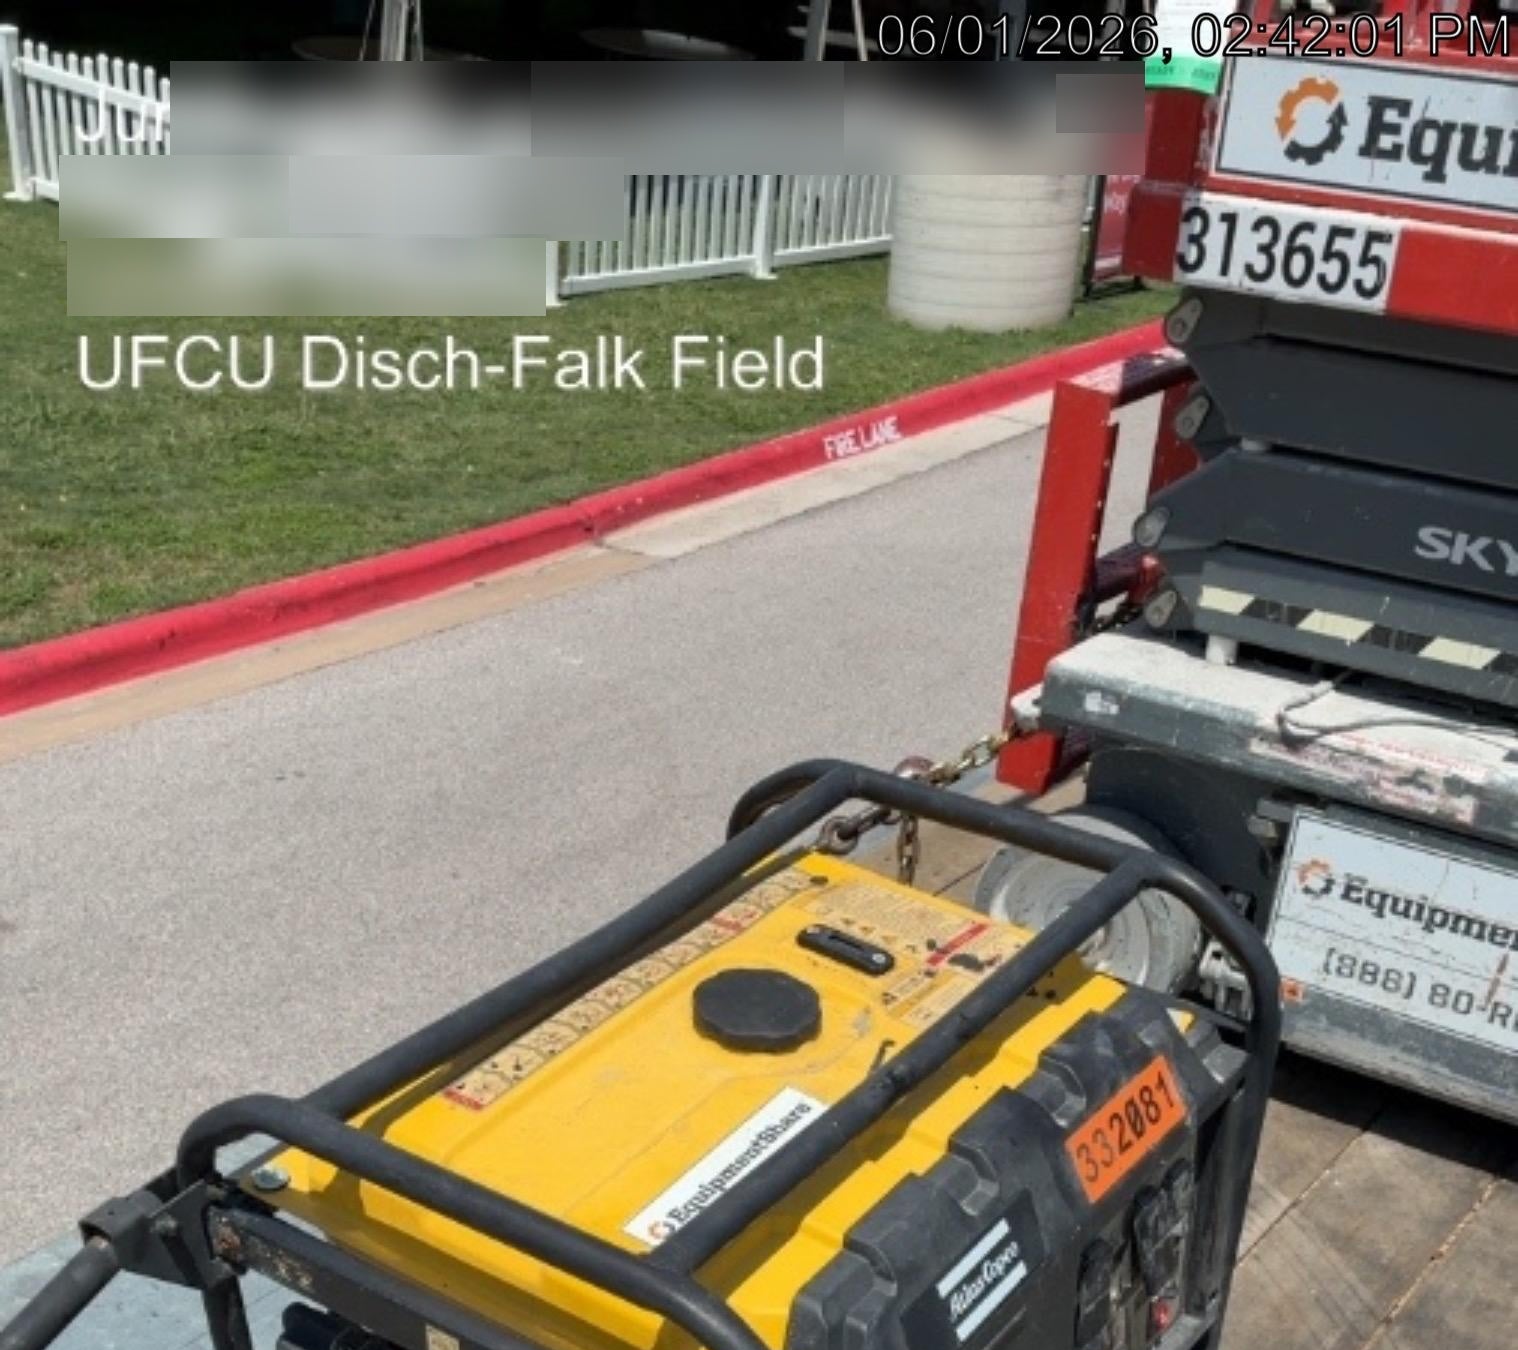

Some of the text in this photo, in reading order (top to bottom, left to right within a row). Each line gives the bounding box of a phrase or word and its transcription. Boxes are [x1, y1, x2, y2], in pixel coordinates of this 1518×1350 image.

[1177, 206, 1394, 299] 313655
[1414, 526, 1518, 577] SKY
[1323, 948, 1518, 1033] (888) 80-R
[666, 1102, 812, 1226] EquipmentShare
[1076, 1071, 1174, 1183] 332081
